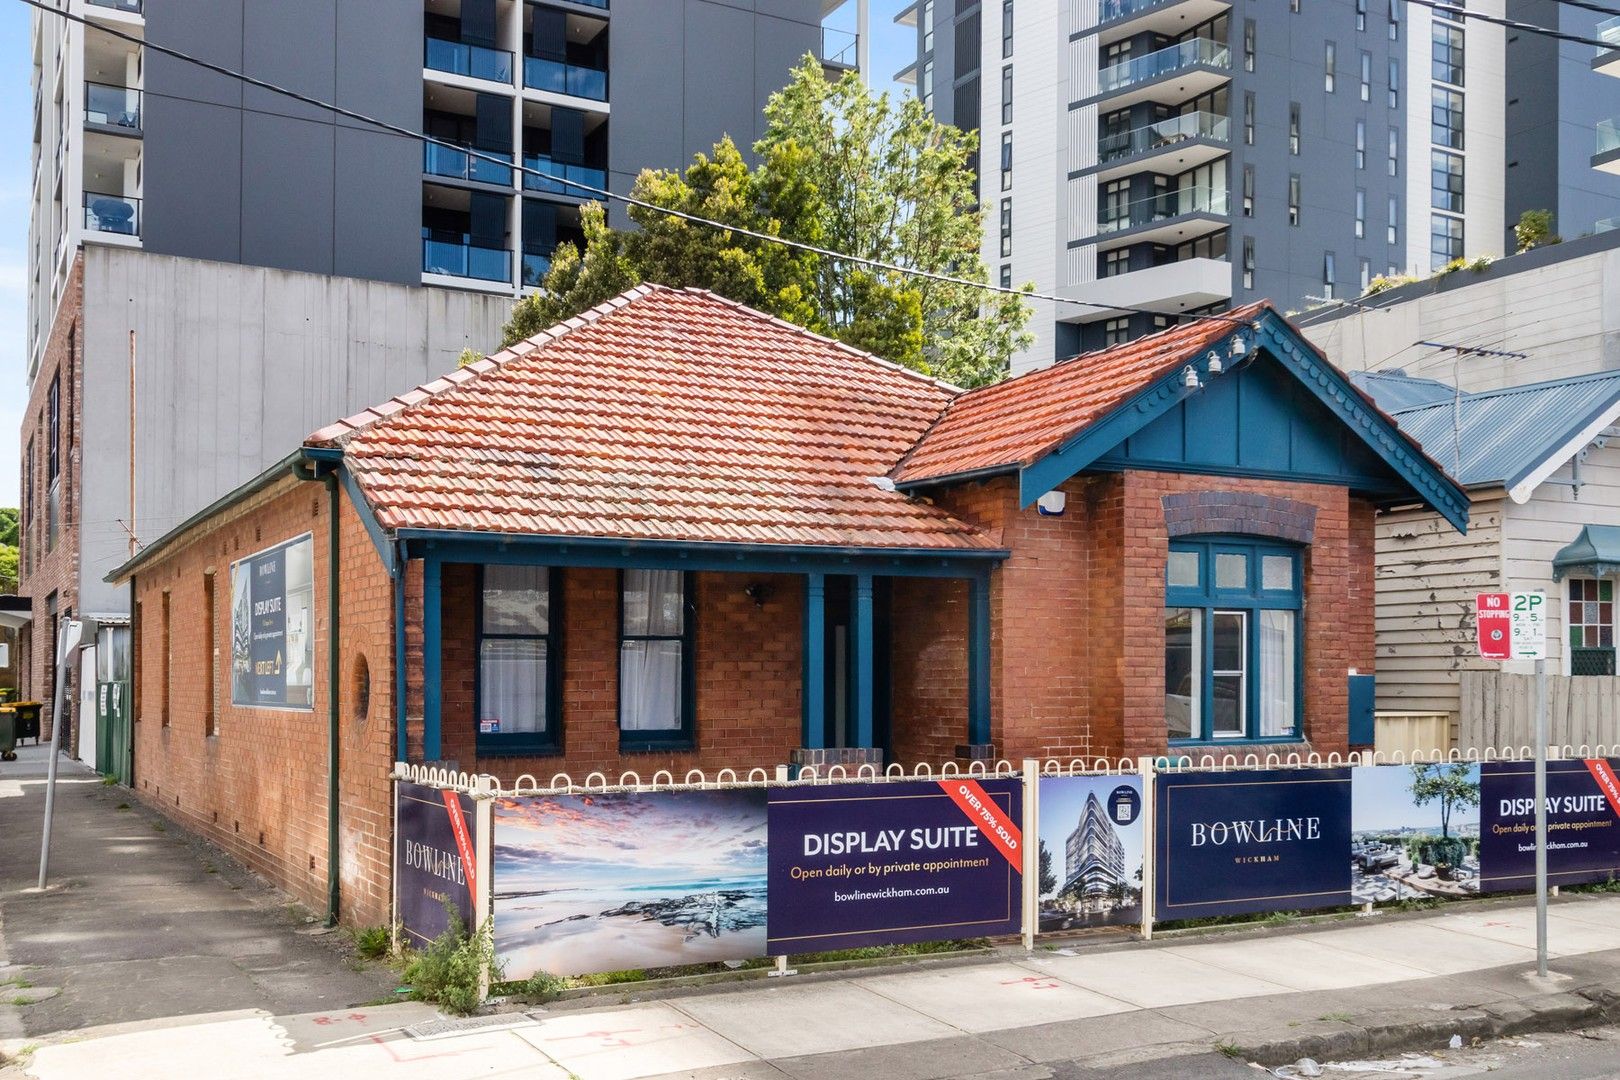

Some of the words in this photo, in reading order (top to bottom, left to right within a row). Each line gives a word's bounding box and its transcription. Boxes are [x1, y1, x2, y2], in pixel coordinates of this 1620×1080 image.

[1486, 596, 1501, 608] NO
[1513, 594, 1543, 611] 2P
[1478, 609, 1510, 619] STOPPING
[1563, 795, 1606, 813] SUITE
[959, 785, 982, 812] OVER
[979, 807, 998, 829] 75%
[995, 825, 1017, 849] SOLD
[1190, 816, 1321, 847] BOWLINE
[1492, 824, 1512, 835] Open
[1513, 823, 1530, 834] daily
[1547, 822, 1571, 833] private
[1571, 819, 1612, 832] appointment
[803, 829, 906, 857] DISPLAY
[910, 826, 979, 850] SUITE
[405, 838, 465, 886] BOWLINE
[1234, 854, 1281, 864] WICKHAM
[790, 866, 823, 881] Open
[825, 864, 853, 878] daily
[854, 865, 866, 875] or
[868, 862, 882, 876] by
[883, 861, 921, 876] private
[922, 857, 990, 874] appointment
[834, 886, 950, 902] bowlinewickham.com.au
